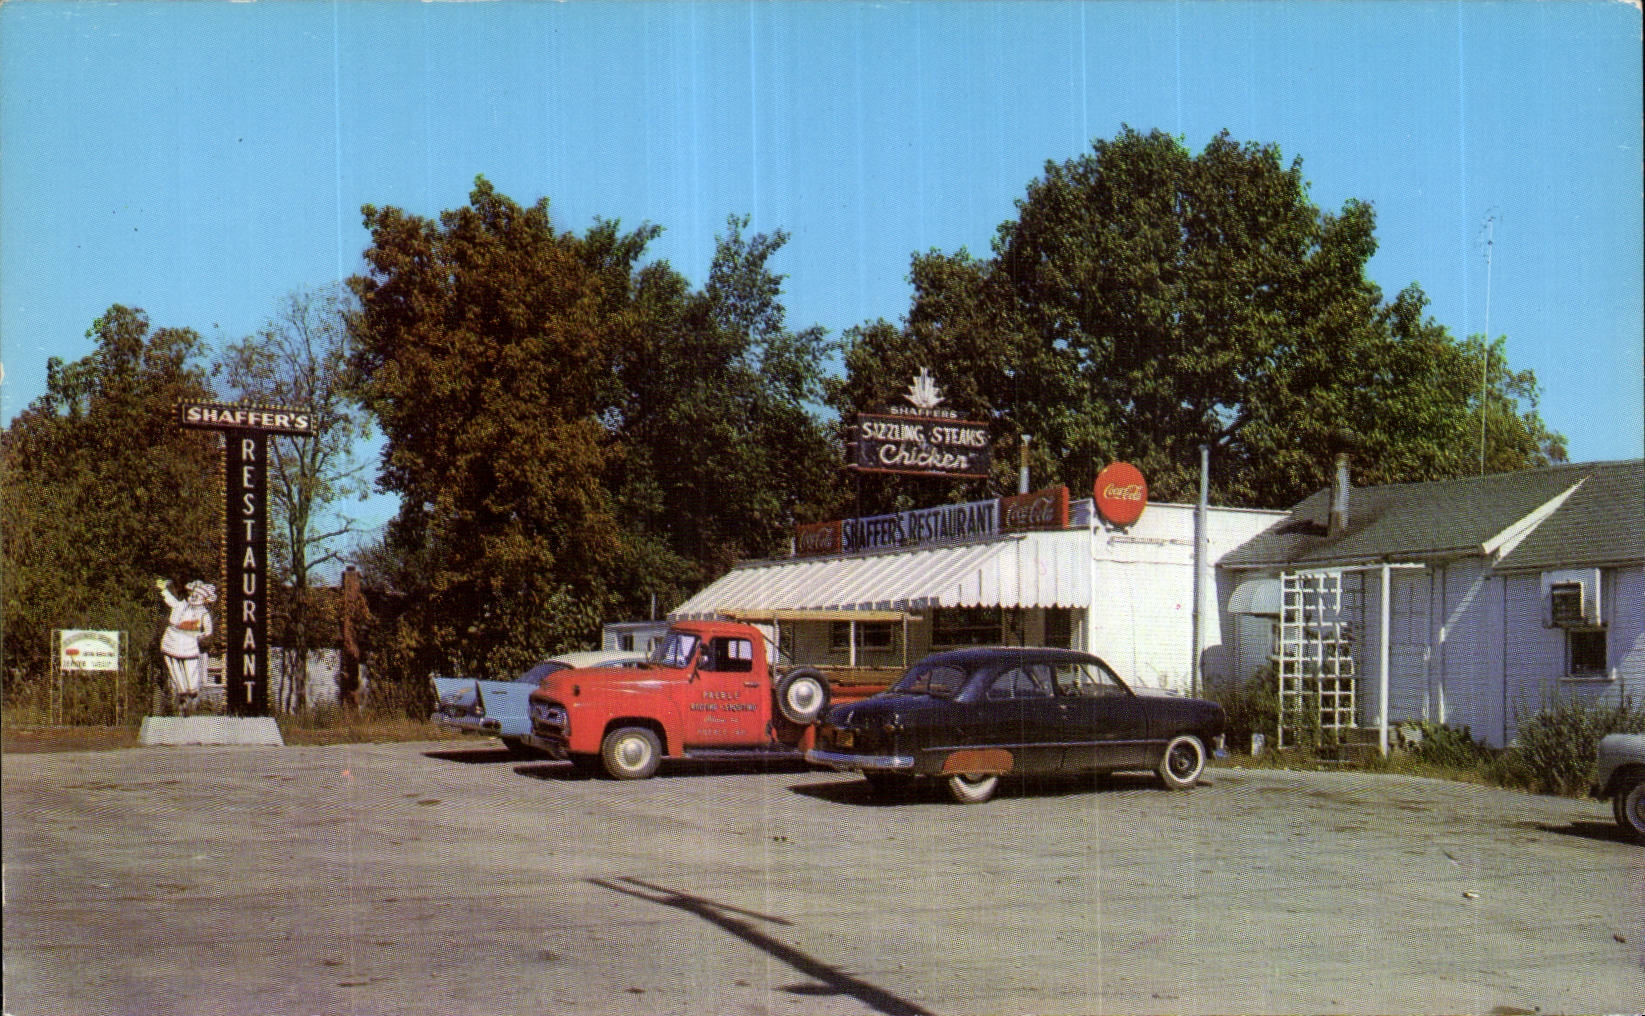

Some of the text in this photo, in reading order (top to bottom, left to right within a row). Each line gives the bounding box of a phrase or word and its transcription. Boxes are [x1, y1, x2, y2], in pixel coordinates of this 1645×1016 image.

[187, 407, 309, 429] SHAFFER'S
[861, 421, 987, 447] SIZZLING STEAKS
[879, 443, 969, 470] Chicken
[907, 503, 995, 542] RESTAURANT
[241, 439, 256, 703] RESTAURANT
